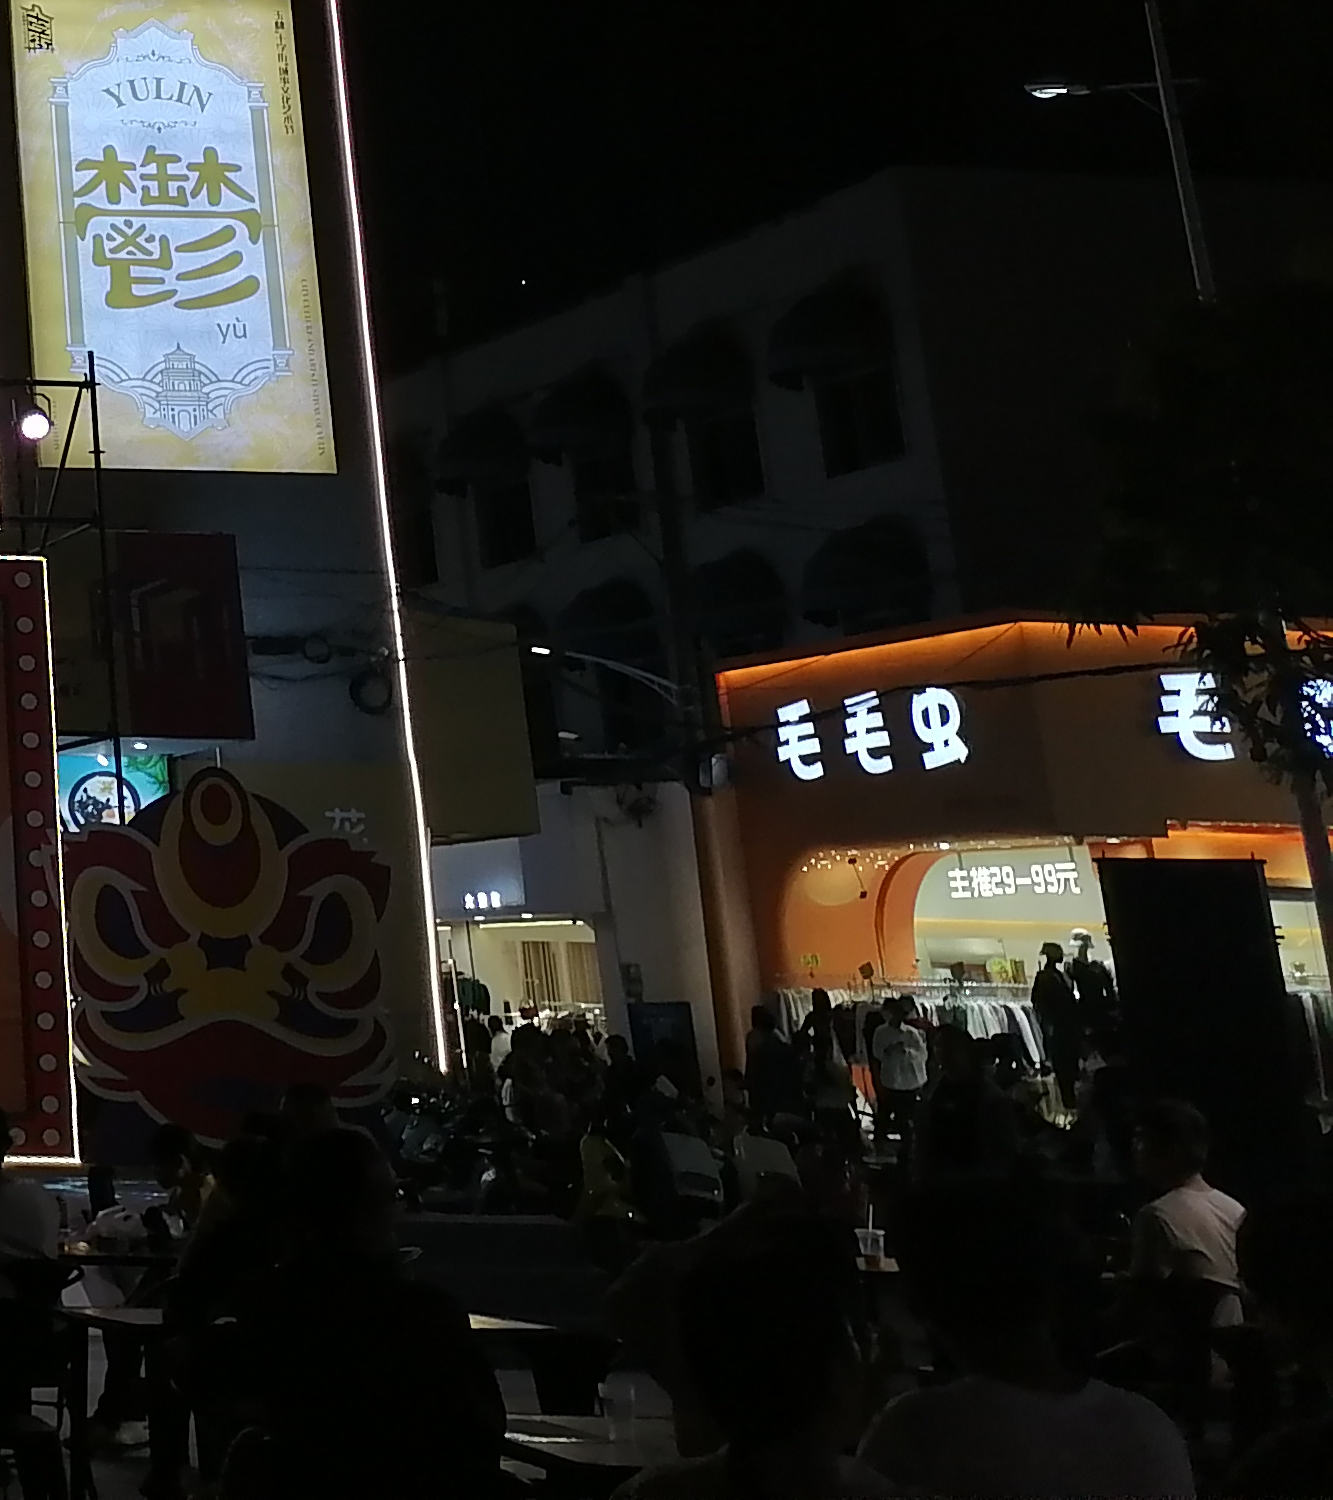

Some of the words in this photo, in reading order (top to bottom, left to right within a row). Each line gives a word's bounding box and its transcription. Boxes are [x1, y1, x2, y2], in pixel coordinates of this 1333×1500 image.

[102, 76, 214, 115] YULIN
[217, 317, 248, 345] yù
[776, 687, 969, 782] 毛毛虫
